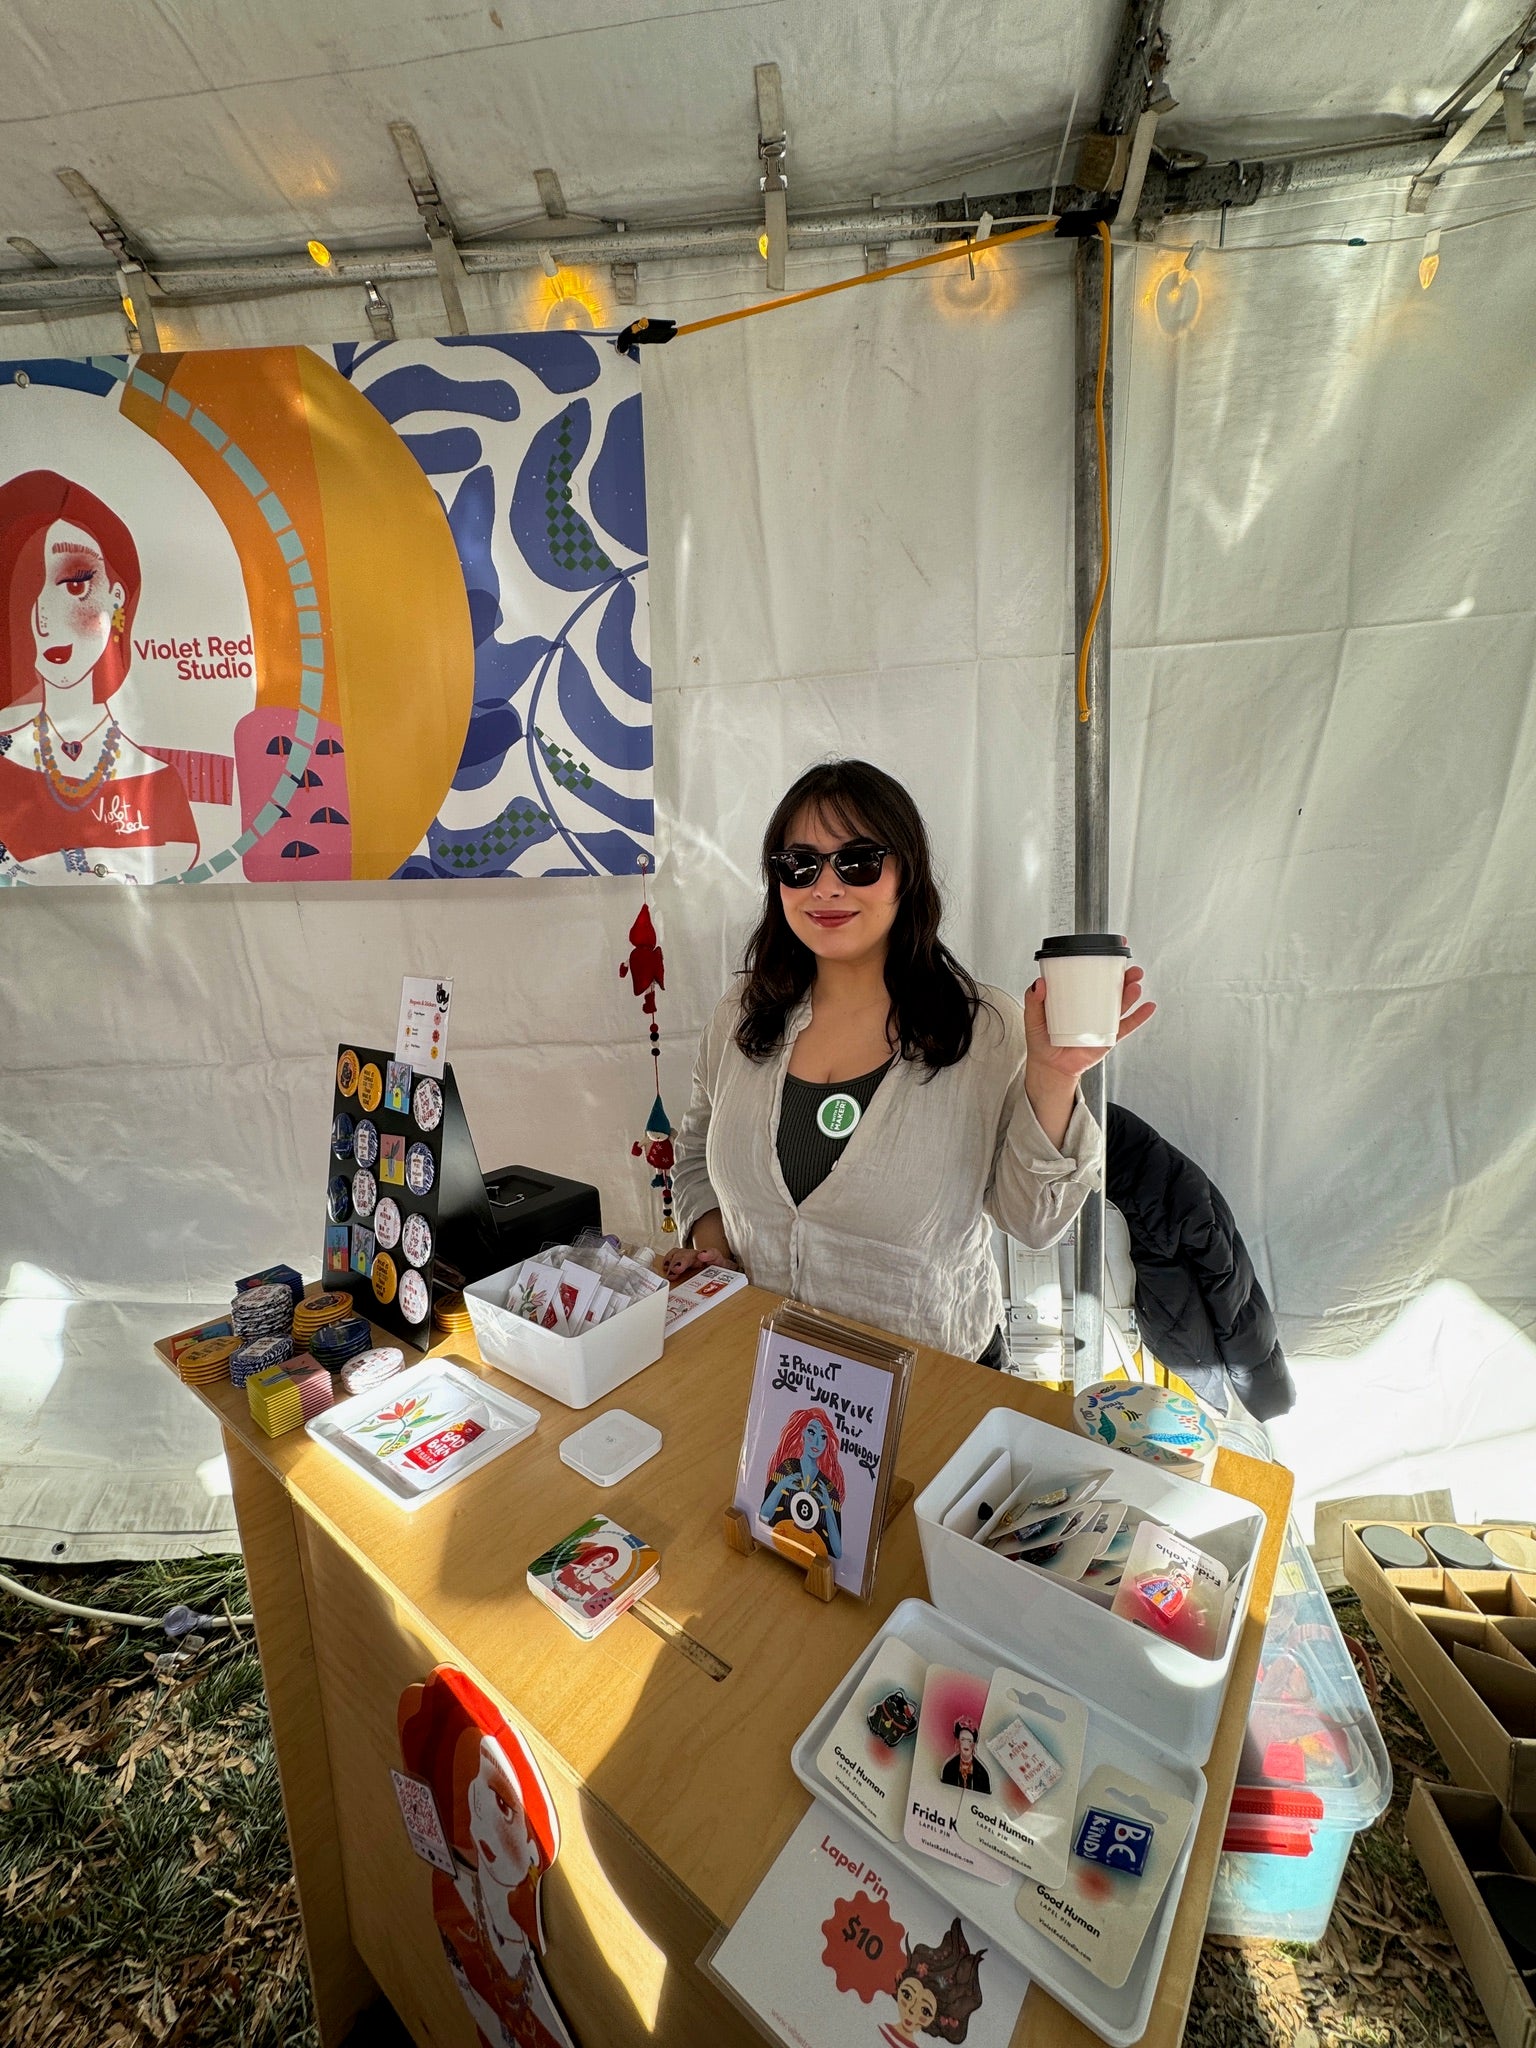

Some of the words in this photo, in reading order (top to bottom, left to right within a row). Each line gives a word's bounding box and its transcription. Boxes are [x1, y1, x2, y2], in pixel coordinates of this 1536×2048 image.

[134, 638, 203, 660] Violet
[208, 635, 253, 657] Red
[177, 657, 253, 680] Studio
[91, 795, 131, 822] Violet
[115, 810, 149, 835] Red
[779, 1354, 790, 1368] I
[440, 1431, 466, 1448] BAD
[800, 1503, 809, 1517] 8
[1192, 1564, 1221, 1587] Frida
[834, 1745, 857, 1771] Good
[855, 1763, 886, 1799] Human
[836, 1761, 851, 1778] LAPEL
[852, 1775, 863, 1787] PIN
[911, 1801, 946, 1827] Frida
[918, 1820, 938, 1834] LAPEL
[970, 1804, 997, 1826] Good
[999, 1818, 1035, 1847] Human
[976, 1821, 995, 1835] LAPEL
[1105, 1822, 1147, 1863] BE
[820, 1834, 865, 1879] Lapel
[863, 1868, 889, 1900] Pin
[1036, 1885, 1064, 1910] Good
[1065, 1904, 1101, 1938] Human
[1039, 1901, 1058, 1919] LAPEL
[1060, 1916, 1072, 1928] PIN
[842, 1914, 884, 1961] $10
